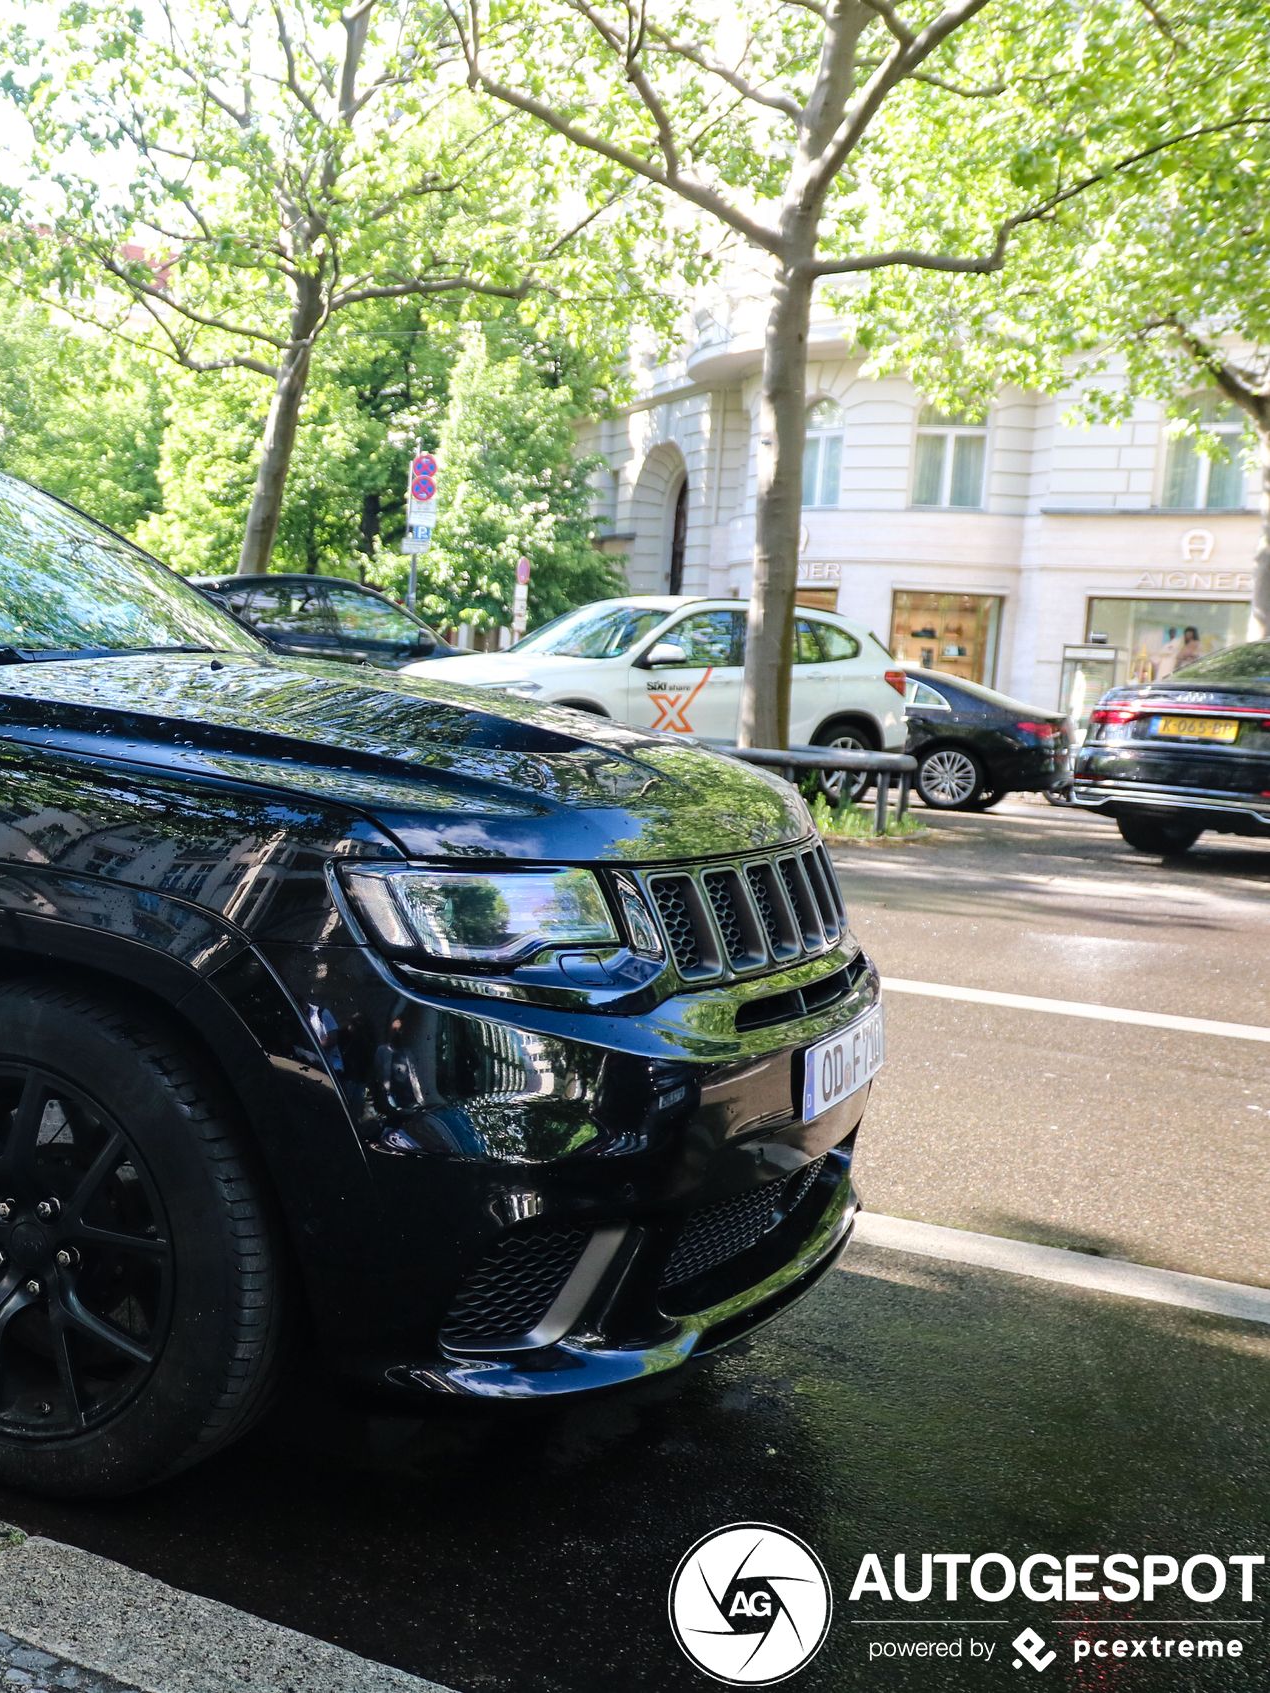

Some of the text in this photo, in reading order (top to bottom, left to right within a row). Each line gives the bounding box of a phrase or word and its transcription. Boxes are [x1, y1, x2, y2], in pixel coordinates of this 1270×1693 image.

[798, 562, 840, 579] NER
[1134, 572, 1254, 589] AIGNER
[823, 1044, 842, 1101] OD
